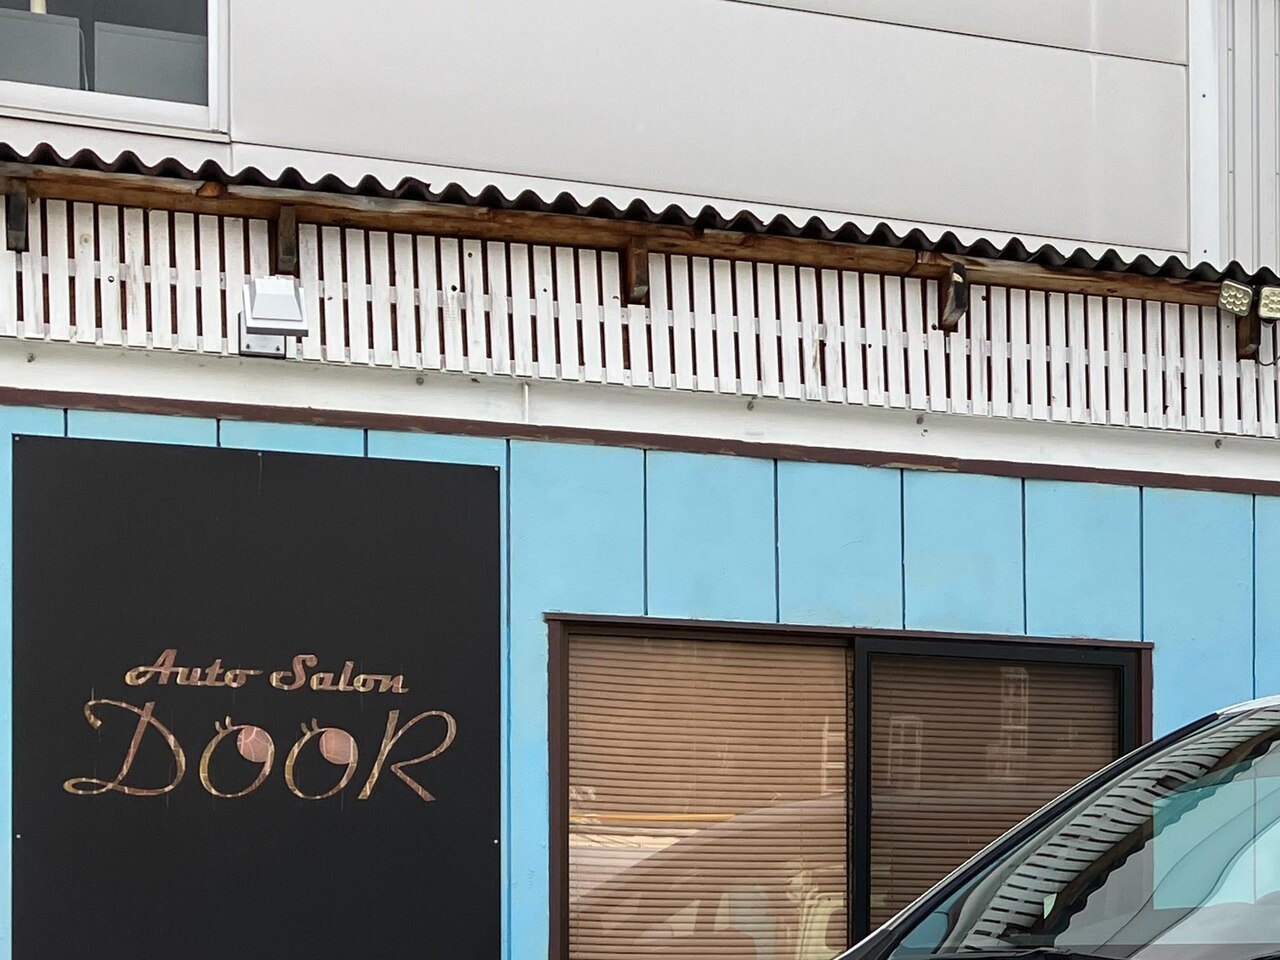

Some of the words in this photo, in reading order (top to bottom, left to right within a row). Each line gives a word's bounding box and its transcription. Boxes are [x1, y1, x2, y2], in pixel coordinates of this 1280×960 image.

[124, 648, 263, 686] Auto
[269, 653, 410, 694] Salon
[62, 698, 458, 802] DOOR
